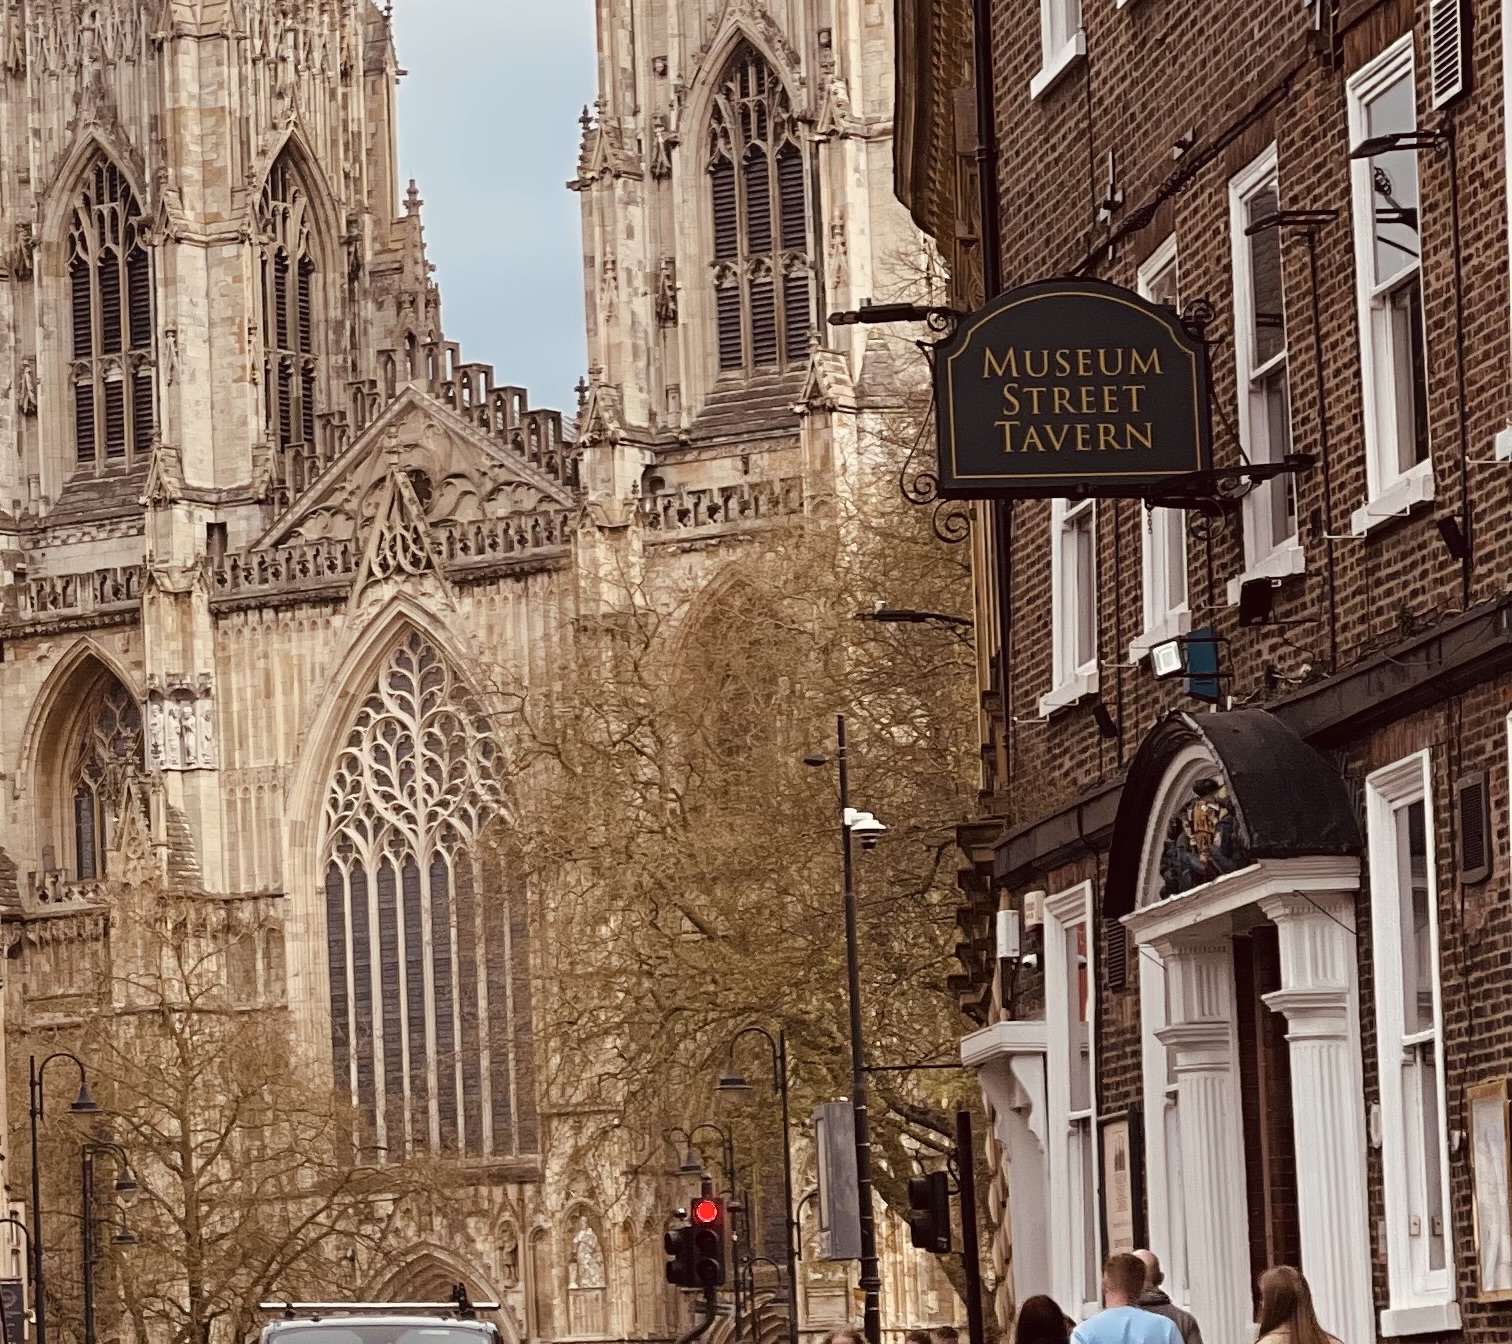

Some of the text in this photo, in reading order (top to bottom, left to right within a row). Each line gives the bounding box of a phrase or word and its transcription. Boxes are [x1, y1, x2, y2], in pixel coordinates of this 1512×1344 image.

[983, 346, 1164, 378] MUSEUM
[1003, 383, 1146, 415] STREET
[994, 421, 1152, 453] TAVERN
